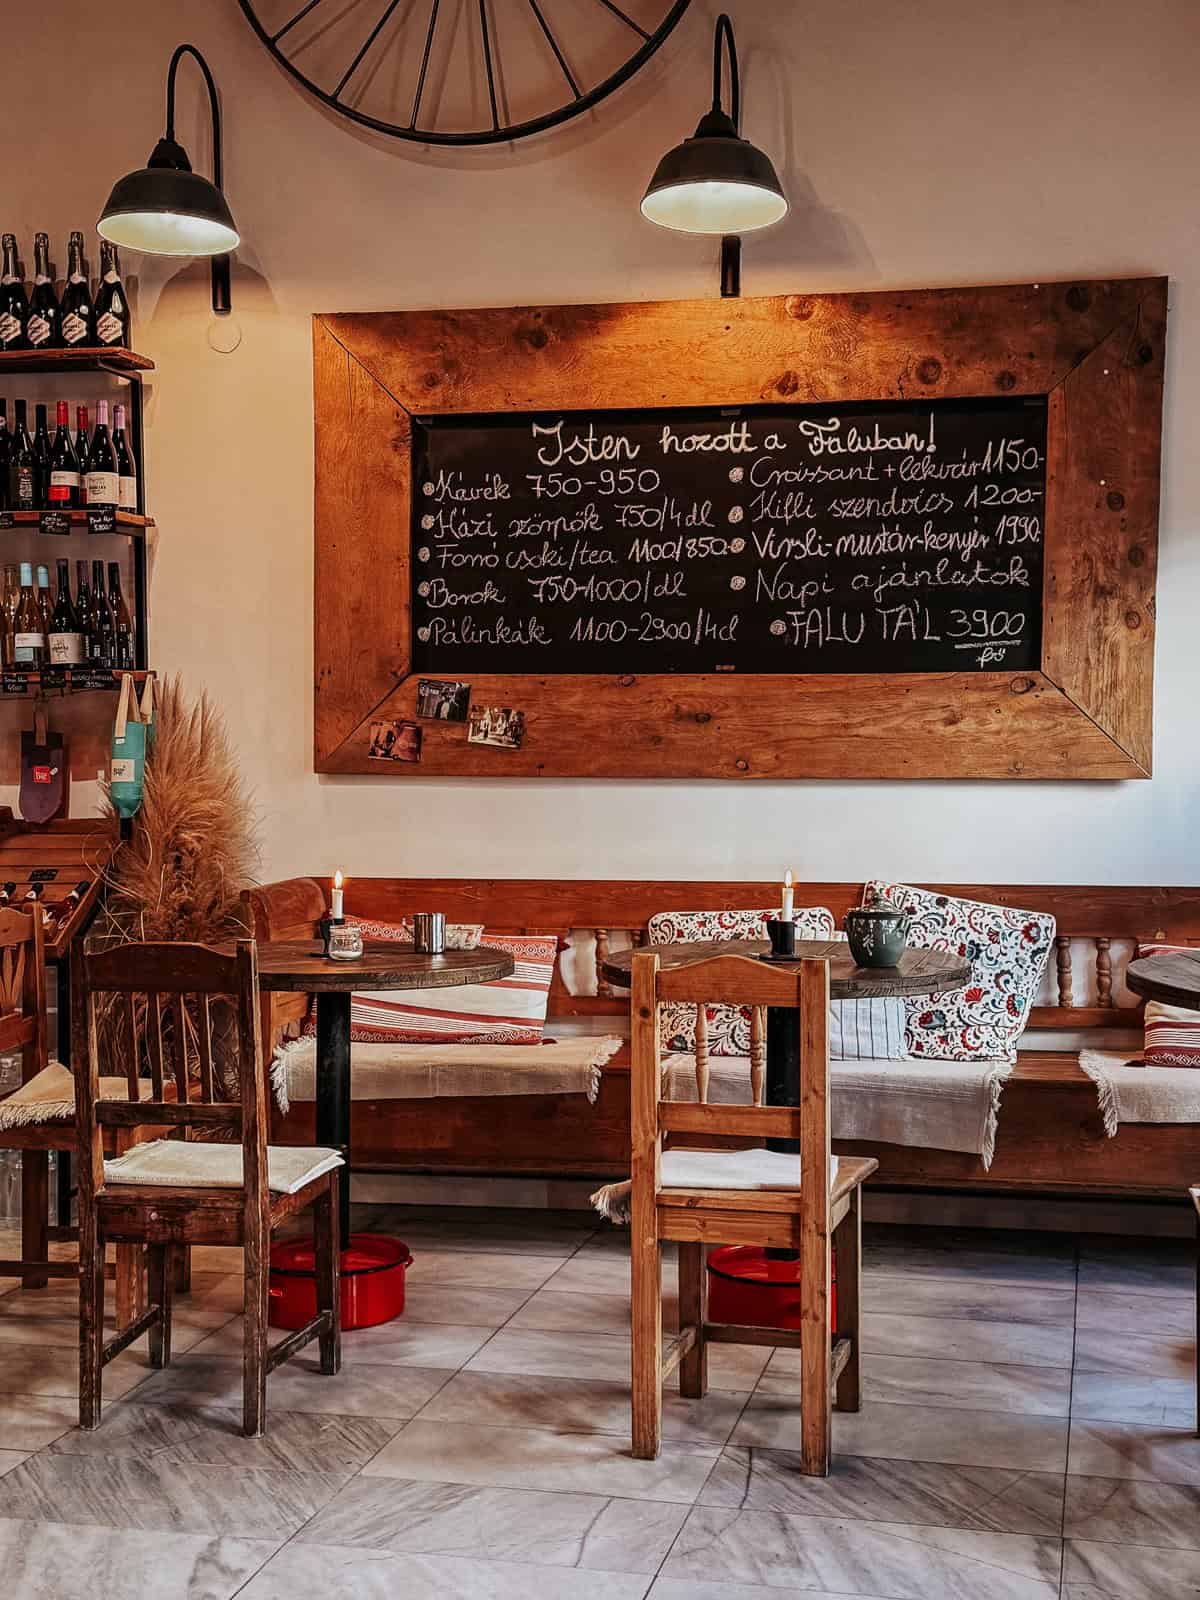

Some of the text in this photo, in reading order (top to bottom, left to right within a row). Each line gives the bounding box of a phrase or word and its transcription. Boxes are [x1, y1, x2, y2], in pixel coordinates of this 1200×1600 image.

[533, 411, 936, 466] Isten hozott a Faluban!
[435, 468, 660, 501] Kávék 750-950
[434, 506, 497, 539] Házi
[426, 577, 506, 608] Borok
[755, 561, 835, 609] Napi
[429, 615, 552, 646] Pálinkák
[945, 609, 1026, 638] 3900
